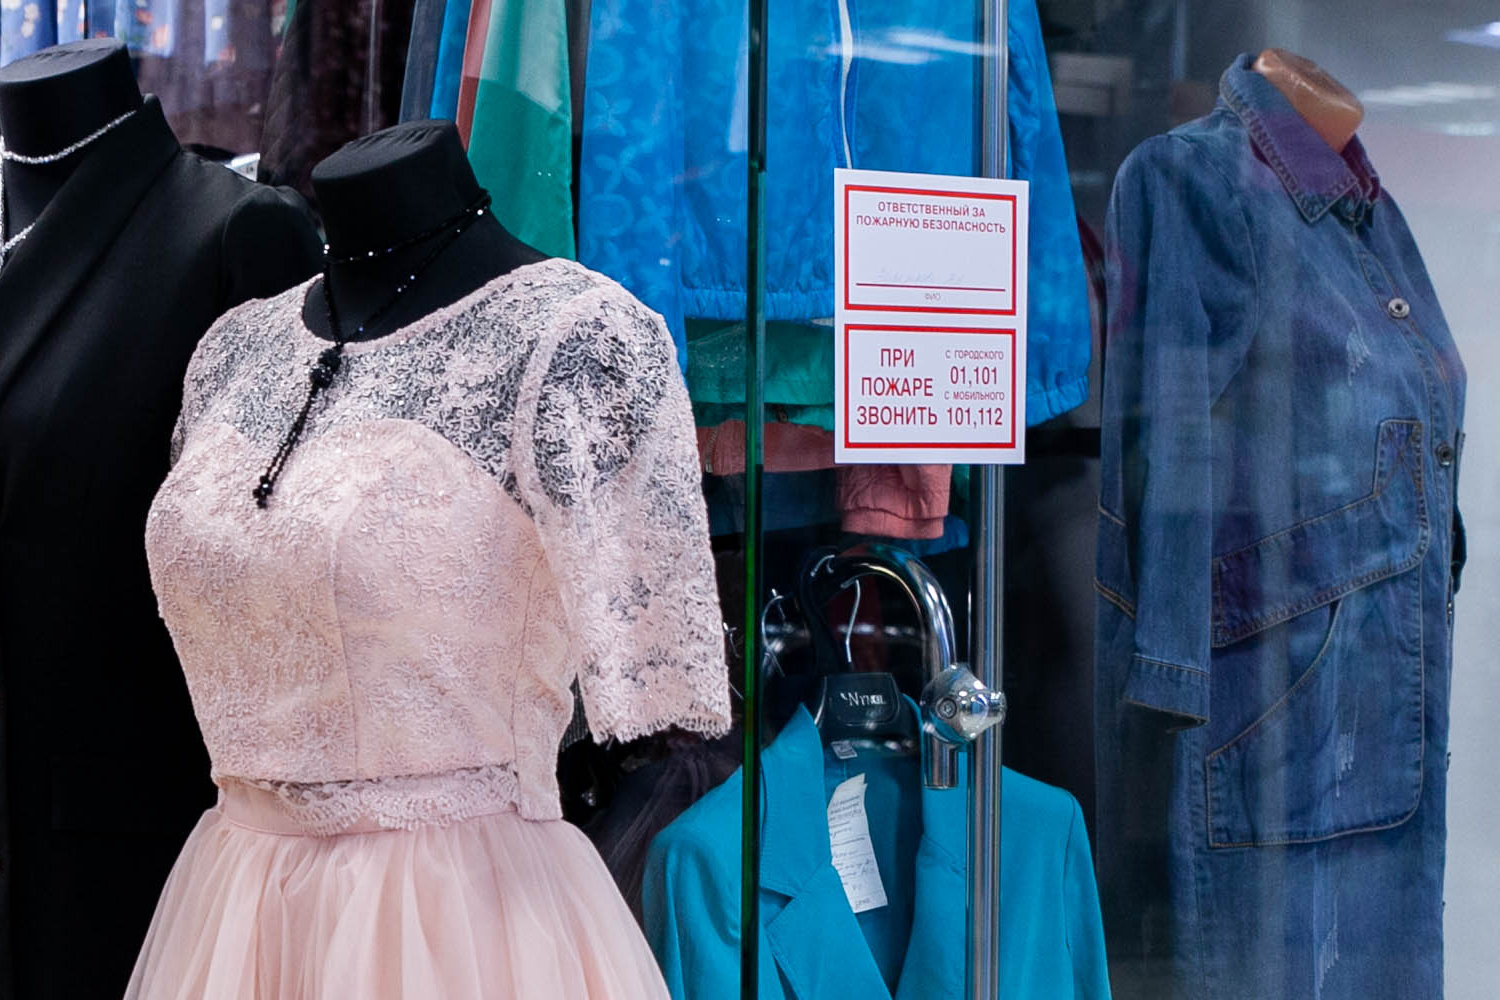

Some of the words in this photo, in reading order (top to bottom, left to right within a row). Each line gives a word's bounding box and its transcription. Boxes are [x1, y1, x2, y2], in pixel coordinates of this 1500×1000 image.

[877, 200, 970, 217] ОТВЕТСТВЕННЫЙ
[972, 206, 986, 218] ЗА
[856, 214, 920, 229] ПОЖАРНУЮ
[922, 218, 1006, 234] БЕЗОПАСНОСТЬ
[880, 348, 915, 368] ПРИ
[954, 350, 1004, 360] ГОРОДСКОГО
[861, 376, 934, 397] ПОЖАРЕ
[950, 366, 998, 388] 01,101
[953, 391, 1005, 401] МОБИЛЬНОГО
[856, 405, 938, 426] ЗВОНИТЬ
[947, 407, 1003, 429] 101,112
